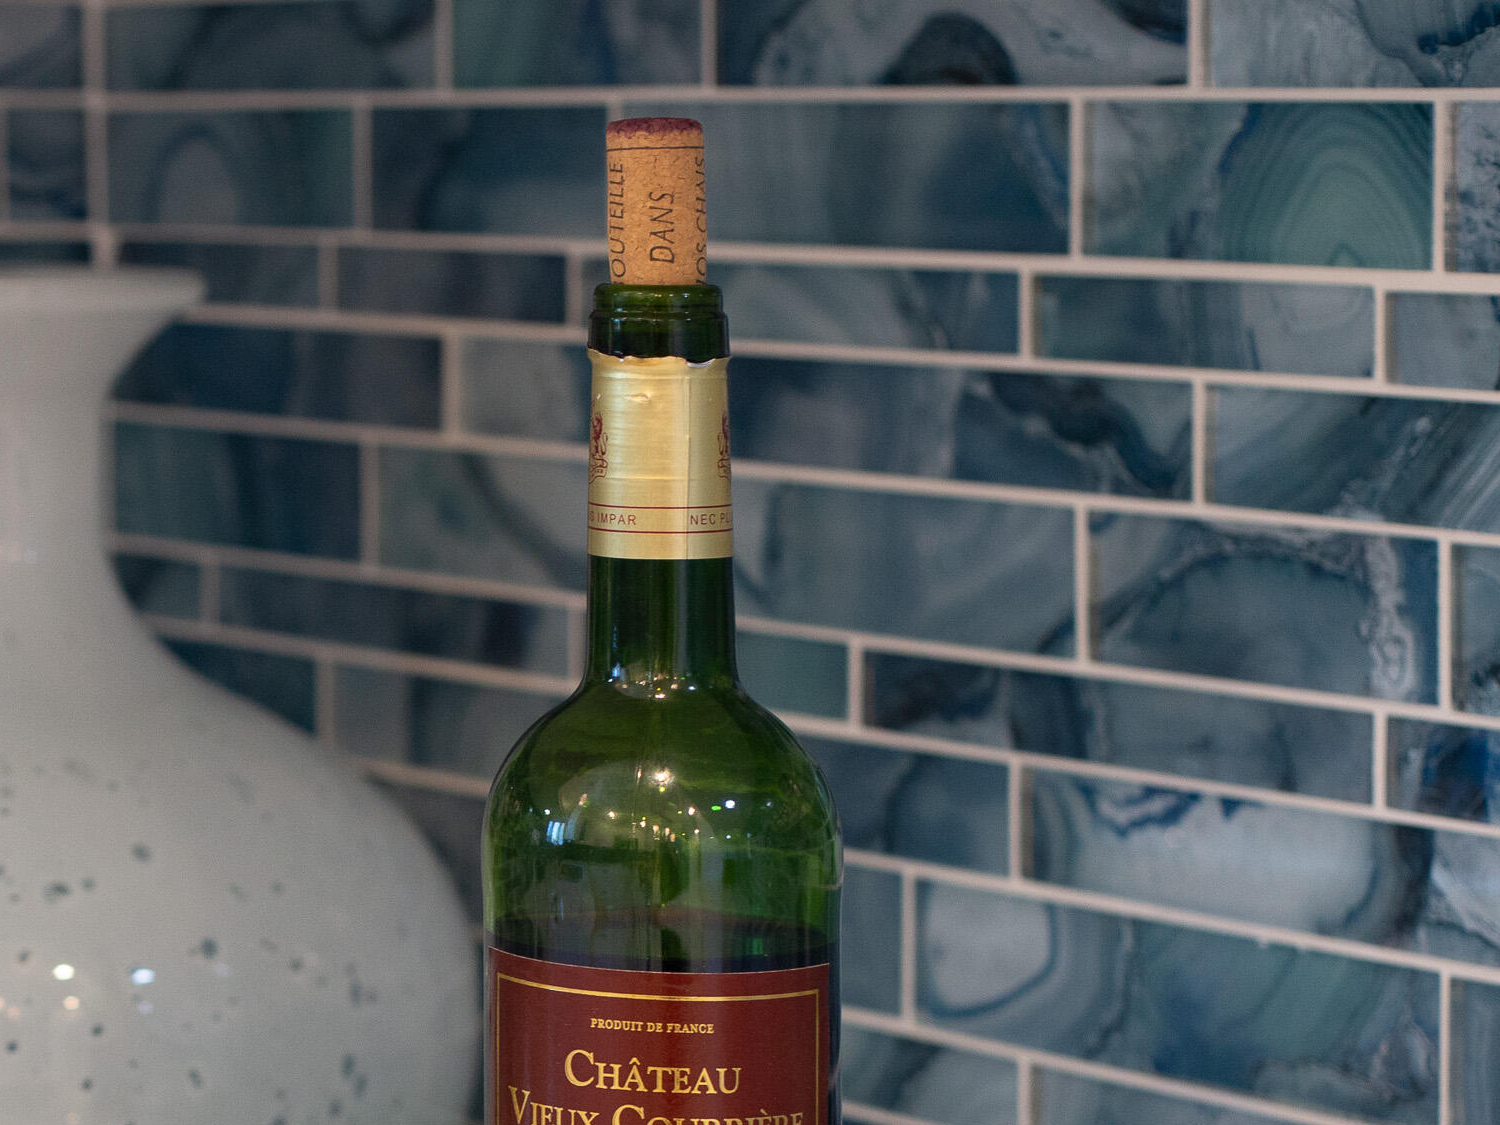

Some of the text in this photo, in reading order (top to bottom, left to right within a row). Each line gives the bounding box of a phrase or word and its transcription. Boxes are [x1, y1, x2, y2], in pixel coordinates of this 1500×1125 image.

[609, 163, 627, 285] OUTEILLE
[648, 191, 675, 264] DANS
[597, 512, 637, 526] IMPAR
[690, 513, 716, 526] NEC
[590, 1018, 715, 1034] PRODUIT DE FRANCE
[564, 1049, 742, 1095] CHÂTEAU
